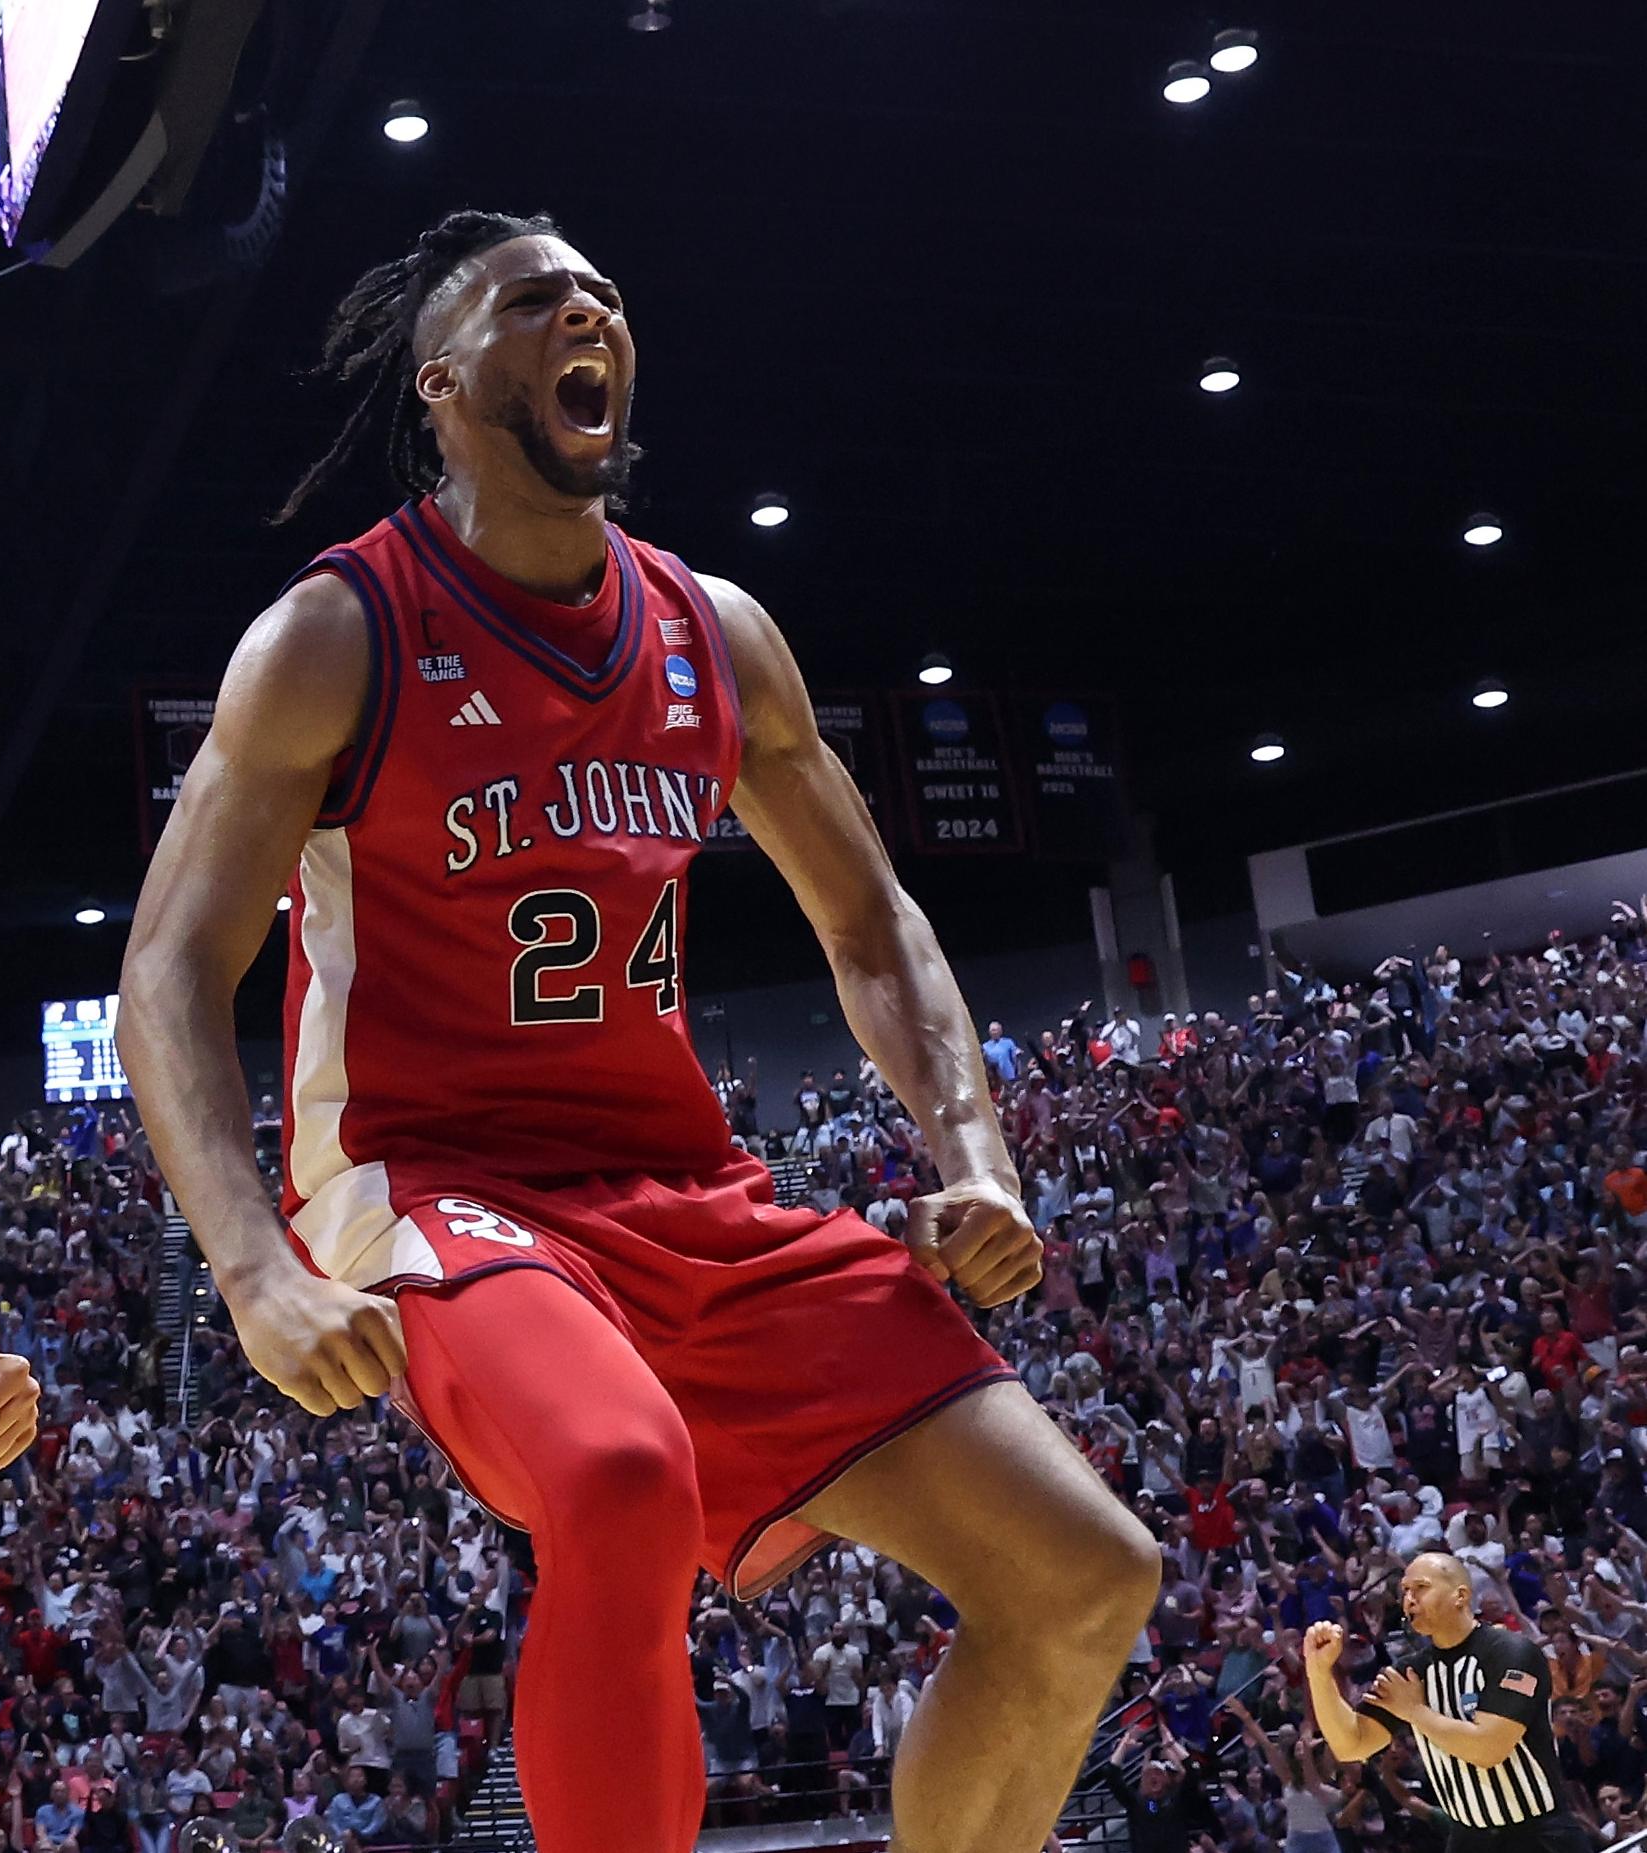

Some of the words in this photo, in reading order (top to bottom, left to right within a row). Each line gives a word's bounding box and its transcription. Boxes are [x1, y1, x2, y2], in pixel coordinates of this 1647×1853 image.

[420, 608, 444, 650] C
[417, 657, 433, 670] BE
[436, 654, 461, 669] THE
[420, 667, 465, 682] HANGE
[668, 704, 694, 715] BIG
[666, 714, 702, 725] EAST
[444, 778, 533, 873] ST.
[937, 818, 998, 840] 2024
[507, 878, 679, 1026] 24
